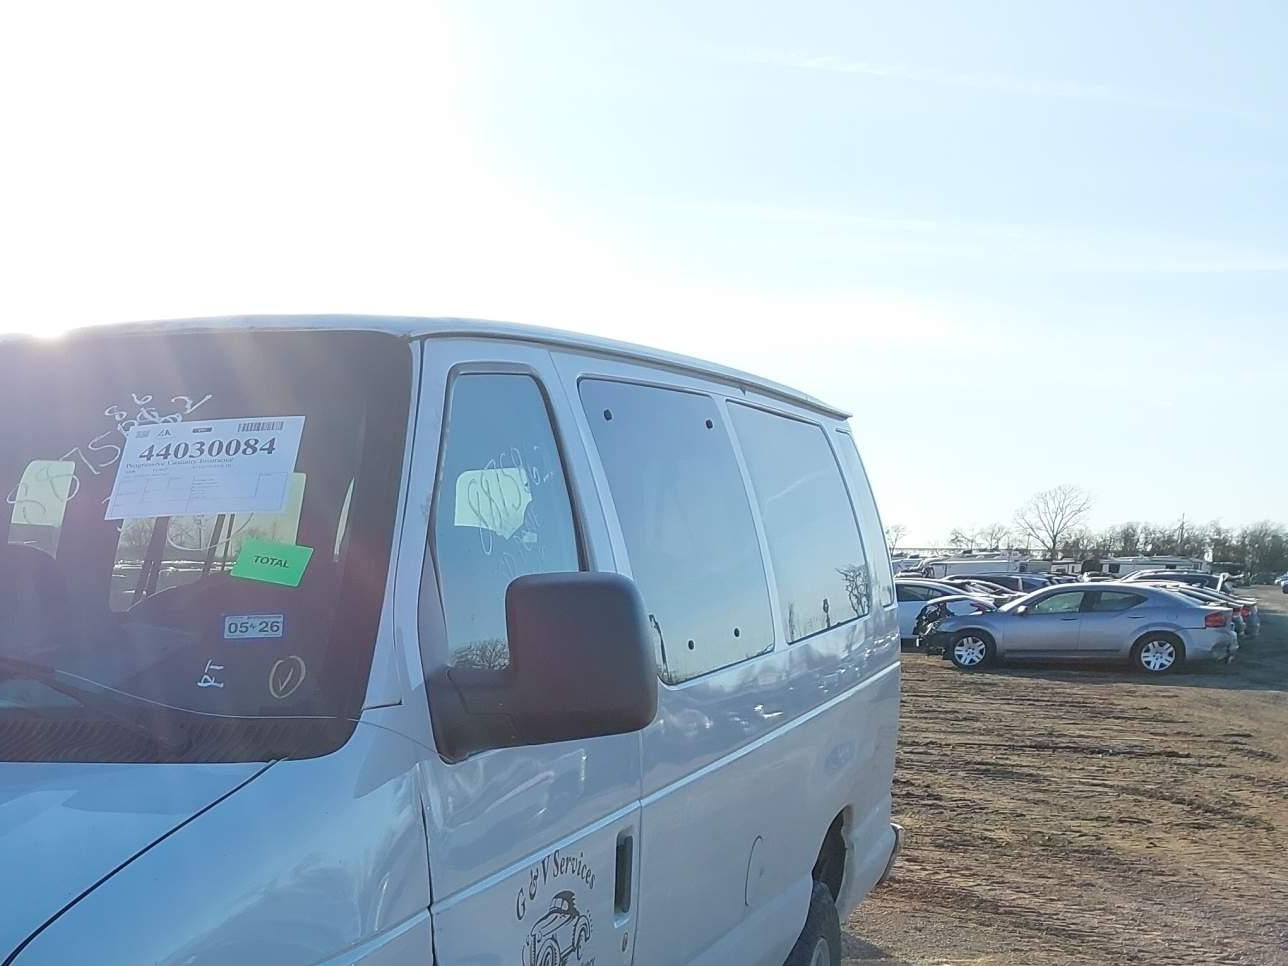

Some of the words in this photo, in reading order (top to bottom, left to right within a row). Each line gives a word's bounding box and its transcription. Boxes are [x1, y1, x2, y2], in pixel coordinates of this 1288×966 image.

[139, 437, 276, 461] 44030084
[253, 555, 289, 569] TOTAL
[228, 622, 249, 634] 05
[258, 620, 280, 632] 26
[516, 887, 526, 920] G
[529, 867, 539, 900] &
[541, 854, 552, 885] V
[553, 849, 595, 889] Services
